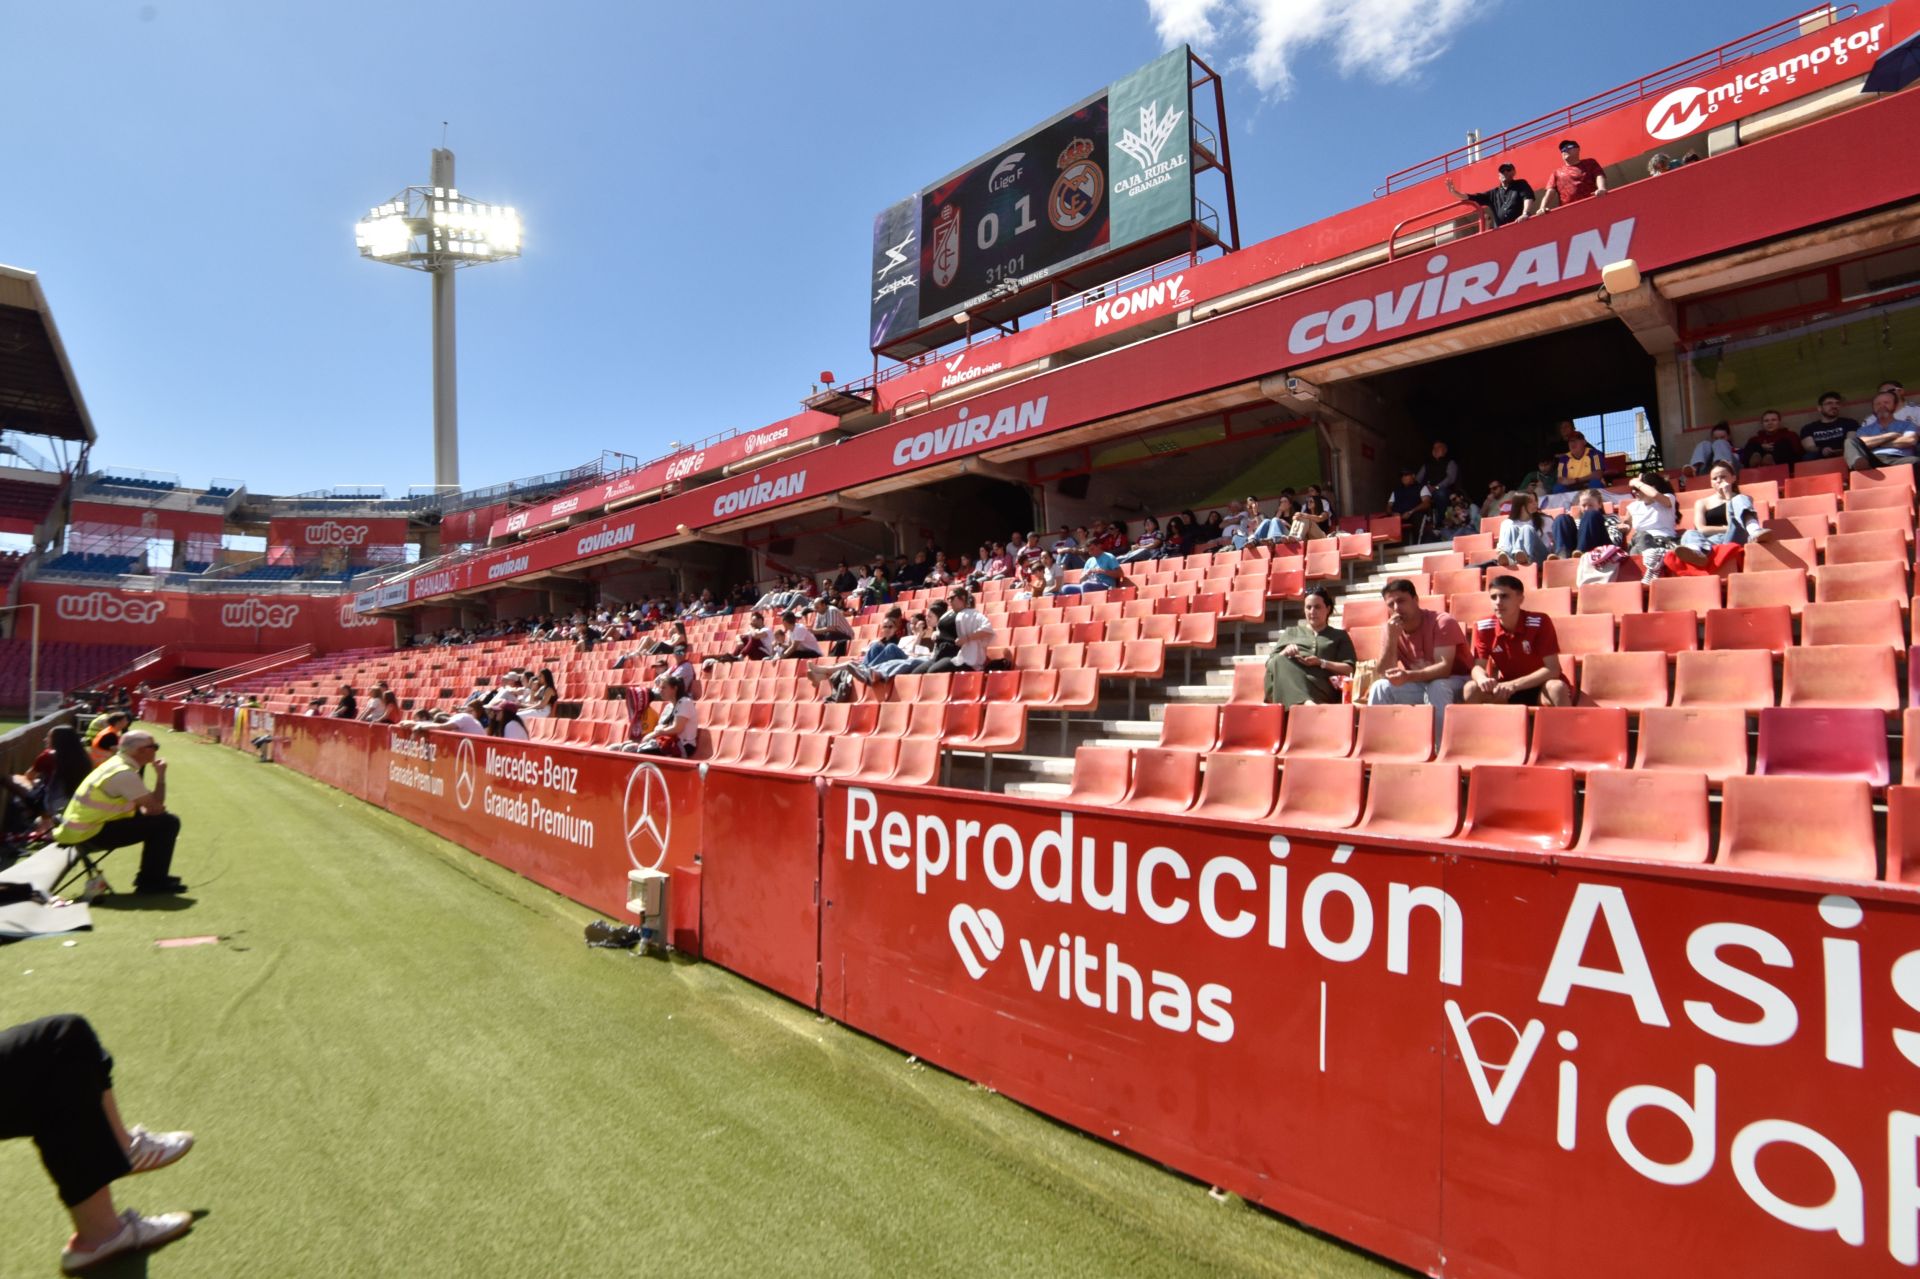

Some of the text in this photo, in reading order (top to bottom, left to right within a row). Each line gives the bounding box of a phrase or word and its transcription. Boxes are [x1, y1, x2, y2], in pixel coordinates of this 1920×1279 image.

[1707, 23, 1884, 105] micamotor
[994, 168, 1023, 190] Liga F
[1114, 154, 1187, 193] CAJA RURAL
[1128, 173, 1171, 196] GRANADA
[977, 212, 999, 250] 0
[1014, 194, 1036, 235] 1
[986, 254, 1024, 283] 31:01
[1094, 275, 1183, 327] KONNY
[941, 366, 981, 388] Halcón
[755, 427, 789, 447] Nucesa
[304, 521, 368, 545] wiber
[506, 512, 529, 533] HSN
[57, 592, 165, 624] wiber
[221, 599, 299, 628] wiber
[485, 747, 578, 794] Mercedes-Benz
[484, 785, 593, 848] Granada Premium
[845, 787, 1920, 1069] Reproducción Asi
[1020, 932, 1234, 1043] vithas
